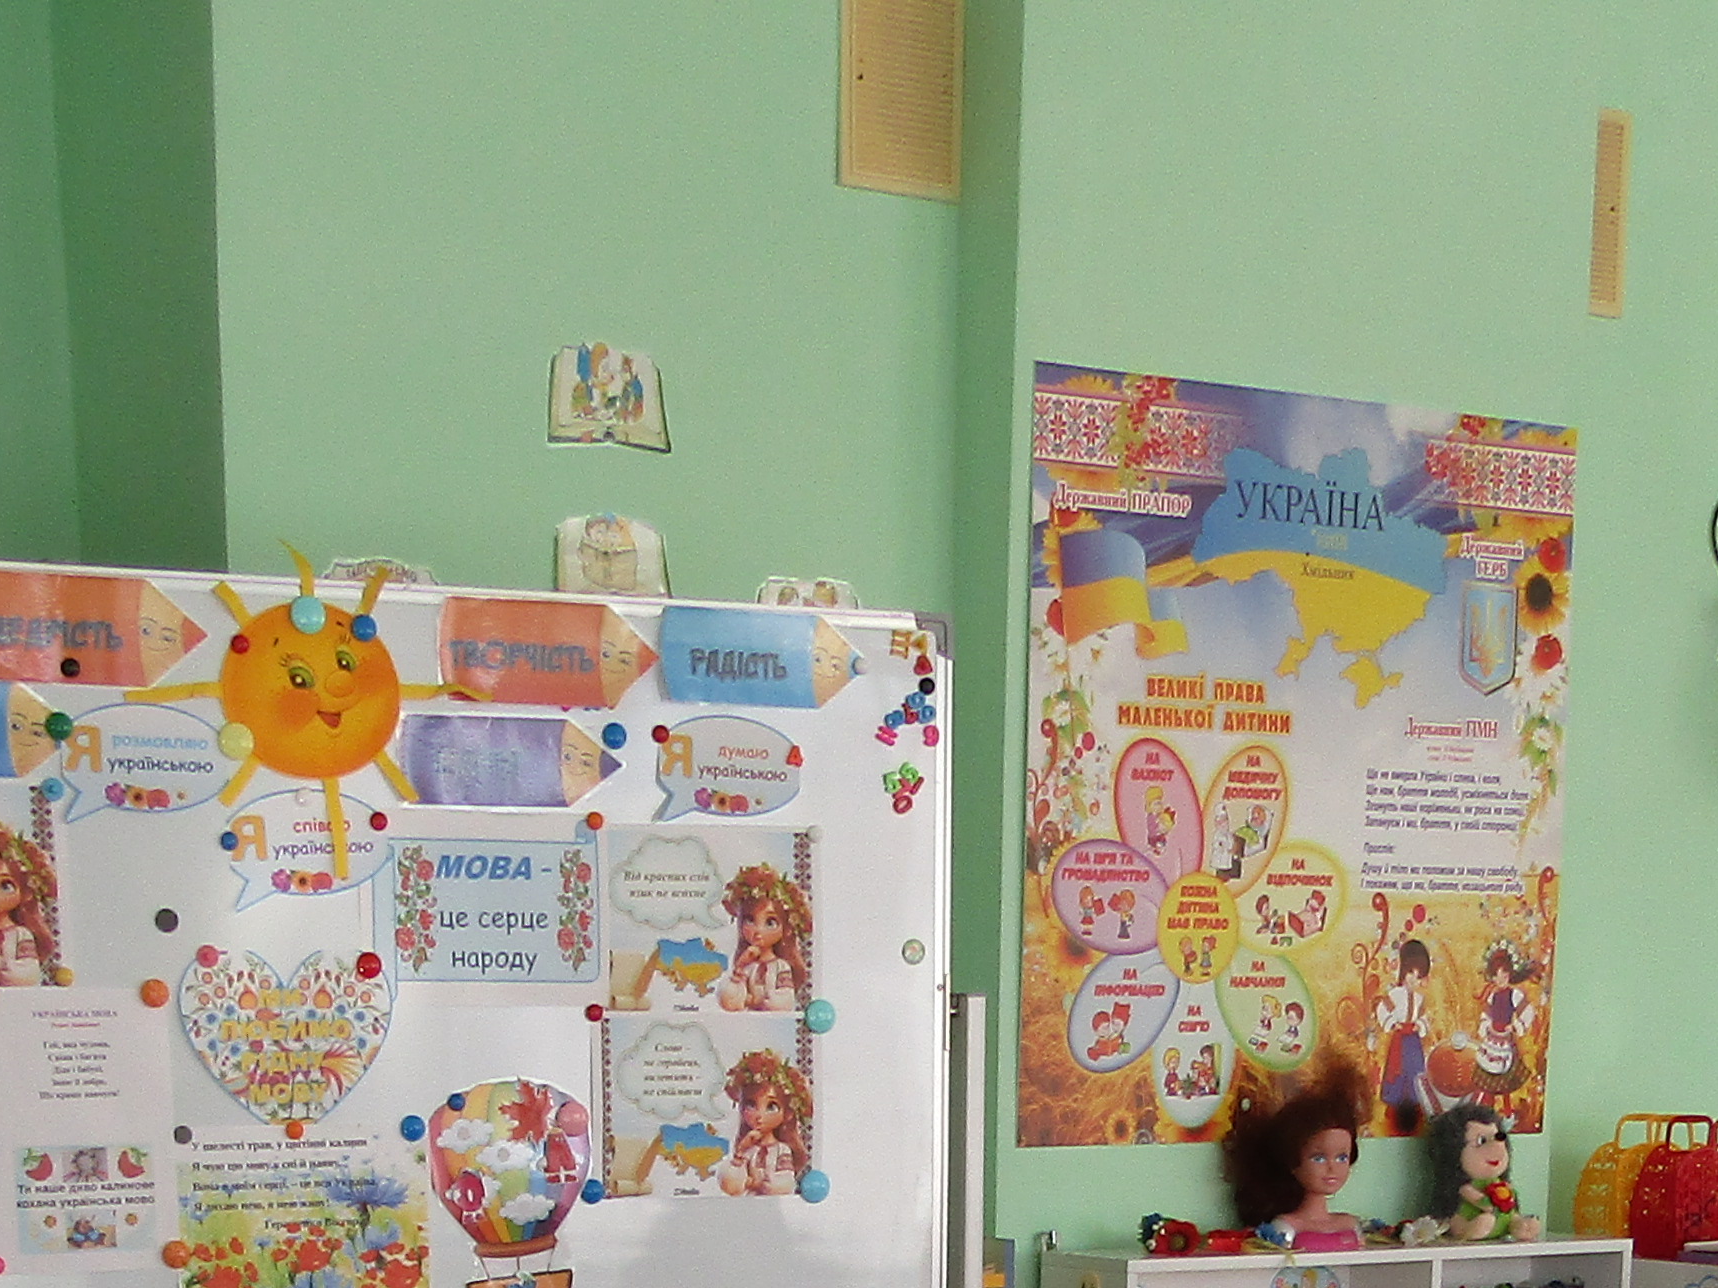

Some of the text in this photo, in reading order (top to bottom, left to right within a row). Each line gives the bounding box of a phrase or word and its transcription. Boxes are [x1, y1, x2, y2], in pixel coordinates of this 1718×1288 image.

[1133, 492, 1193, 516] ПРАПОР
[1236, 479, 1386, 531] УКРАЇНА
[1477, 561, 1507, 577] ГЕРБ
[689, 648, 788, 681] РАДІСТЬ
[1146, 674, 1265, 703] ВЕЛИКІ ПРАВА
[1118, 704, 1291, 733] МАЛЕНЬКОЇ ДИТИНИ
[65, 725, 103, 773] Я
[661, 733, 693, 777] Я
[718, 745, 769, 760] думаю
[106, 755, 214, 775] українською
[697, 763, 788, 784] українською
[230, 815, 269, 862] Я
[293, 819, 351, 836] співю
[272, 840, 374, 860] українсою
[436, 855, 533, 881] МОВА
[440, 912, 549, 935] це серце
[451, 951, 537, 979] народу
